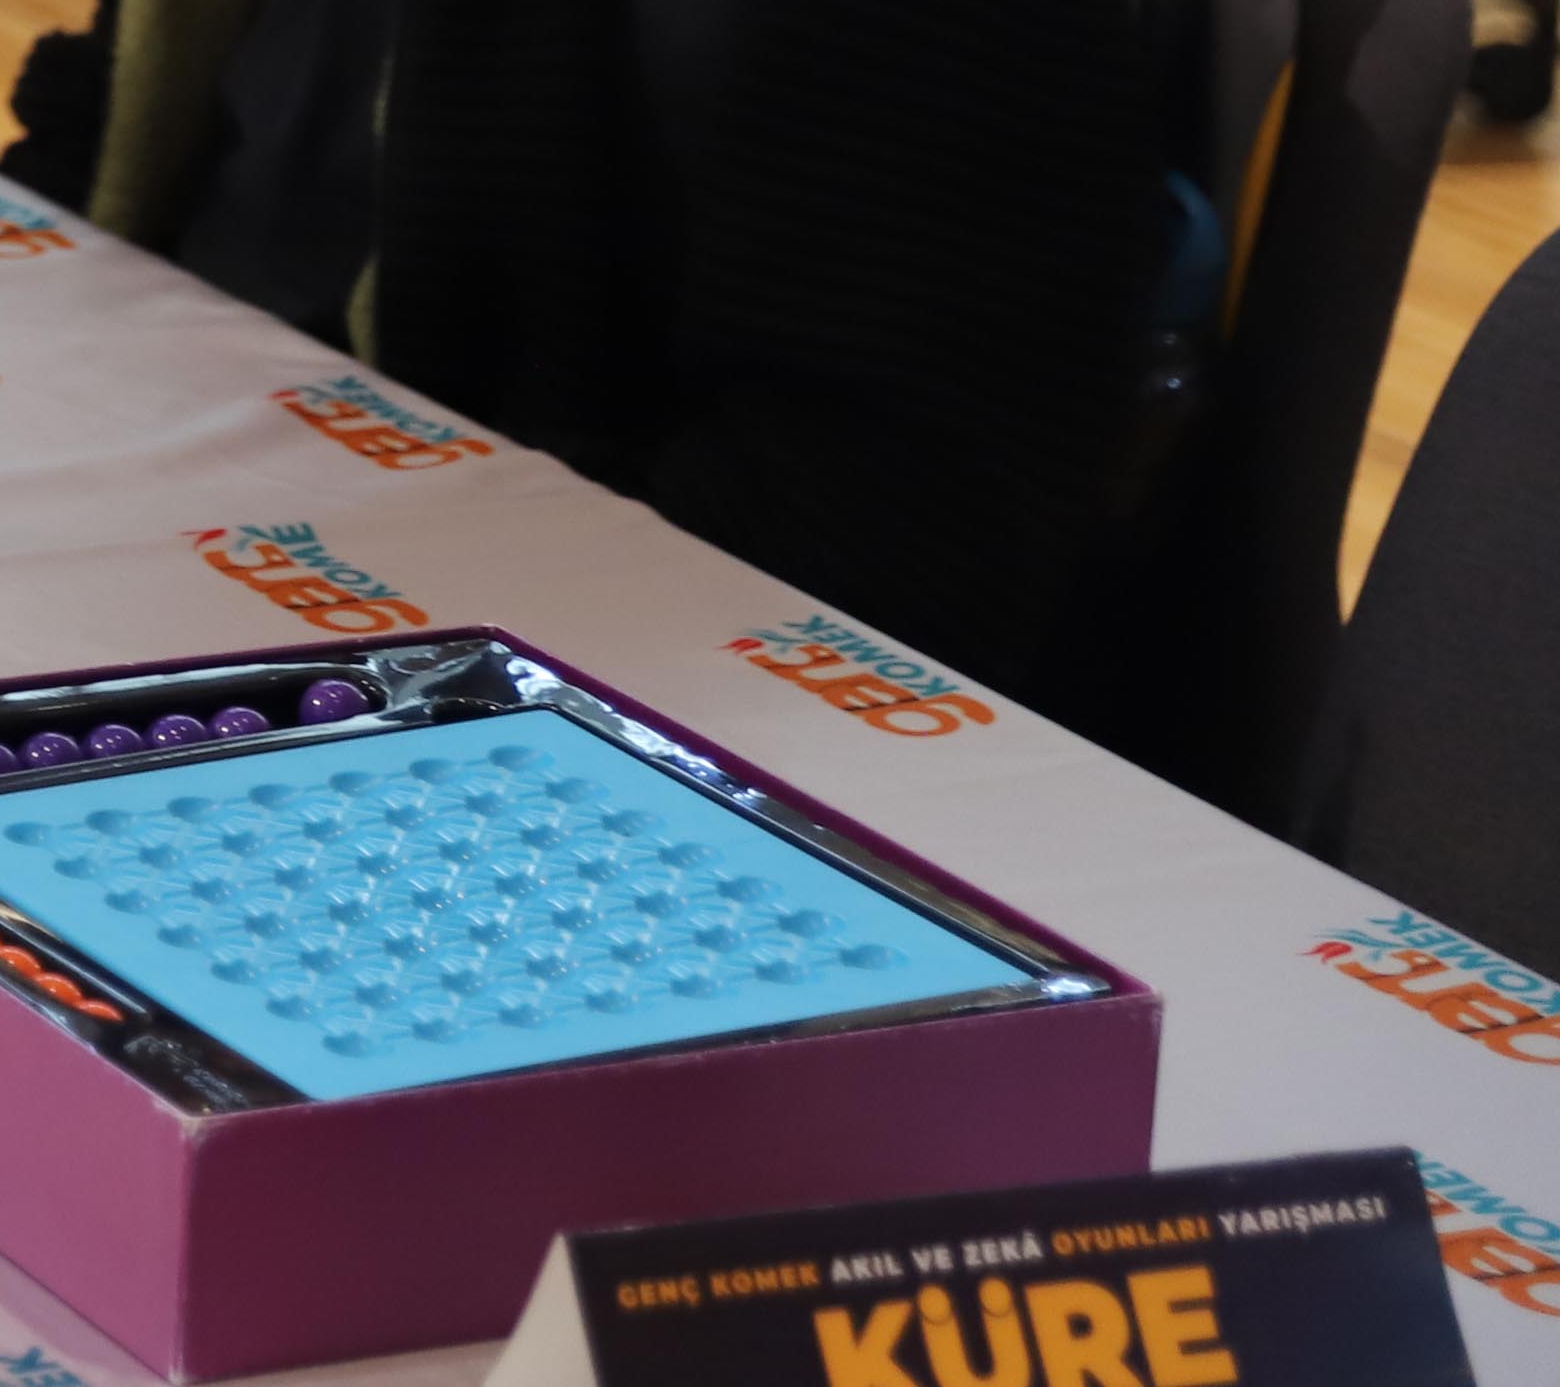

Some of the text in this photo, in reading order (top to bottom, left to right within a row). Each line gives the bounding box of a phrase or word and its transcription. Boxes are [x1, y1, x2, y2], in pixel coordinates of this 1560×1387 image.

[280, 389, 498, 473] genç
[326, 375, 456, 443] KOMEK
[201, 537, 433, 637] genç
[746, 637, 998, 739] genç
[782, 614, 960, 696] KOMEK
[617, 1277, 702, 1309] GENÇ
[710, 1261, 820, 1298] KOMEK
[830, 1252, 904, 1284] AKIL
[911, 1240, 954, 1273] VE
[1051, 1214, 1210, 1258] OYUNLARI
[1218, 1195, 1387, 1239] YARIŞMASI
[812, 1264, 1240, 1387] KÜRE
